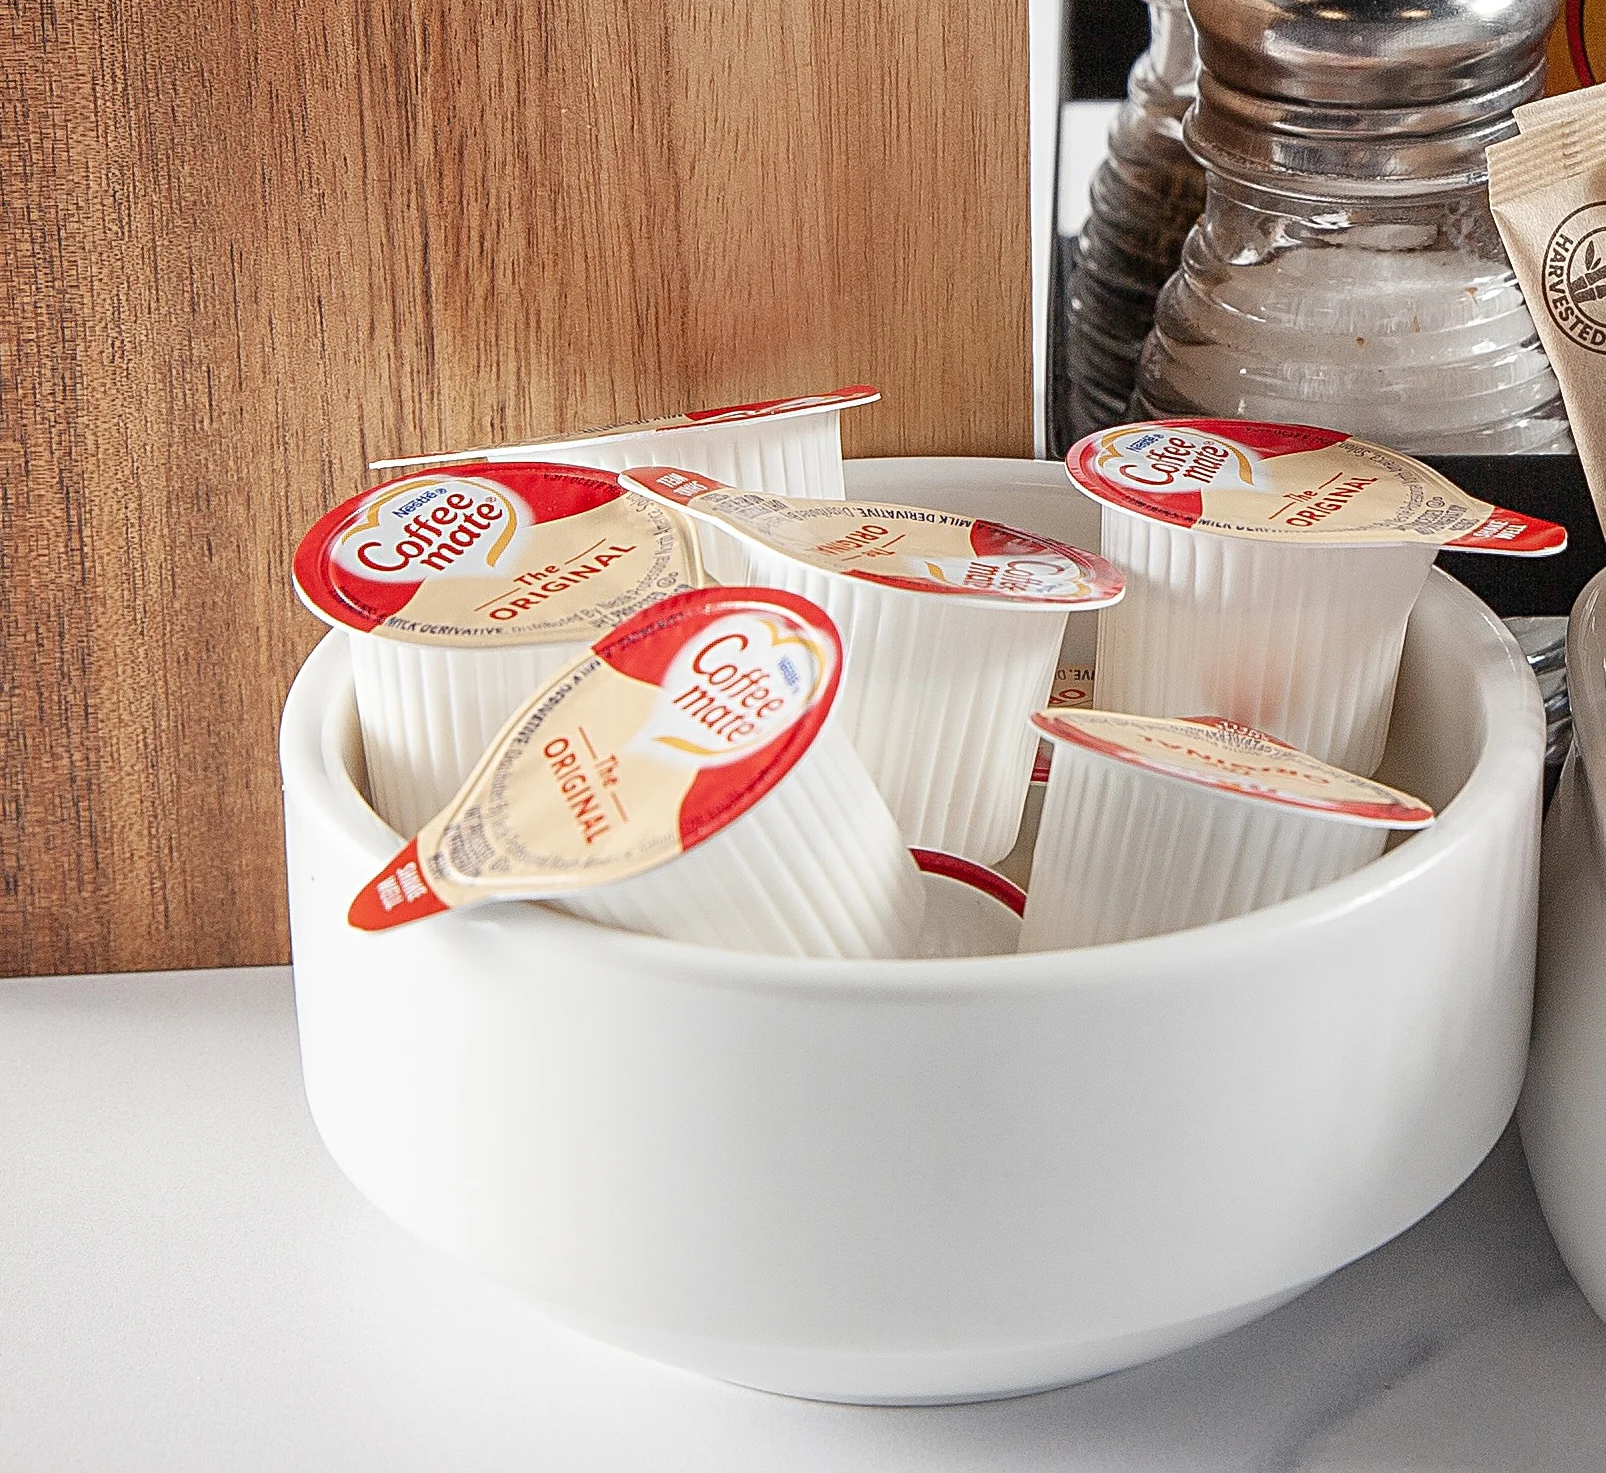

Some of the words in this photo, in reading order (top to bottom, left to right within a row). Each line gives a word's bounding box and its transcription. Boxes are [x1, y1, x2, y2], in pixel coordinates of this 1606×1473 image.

[1548, 233, 1606, 346] HARVESTED
[1118, 437, 1197, 486] Coffee
[357, 493, 474, 572] Coffee
[940, 514, 972, 528] MILK
[1286, 477, 1379, 527] ORIGINAL
[420, 503, 503, 571] mate
[489, 545, 637, 620] ORIGINAL
[513, 564, 561, 586] The
[692, 633, 784, 718] Coffee
[673, 685, 755, 742] mate
[543, 737, 612, 845] ORIGINAL
